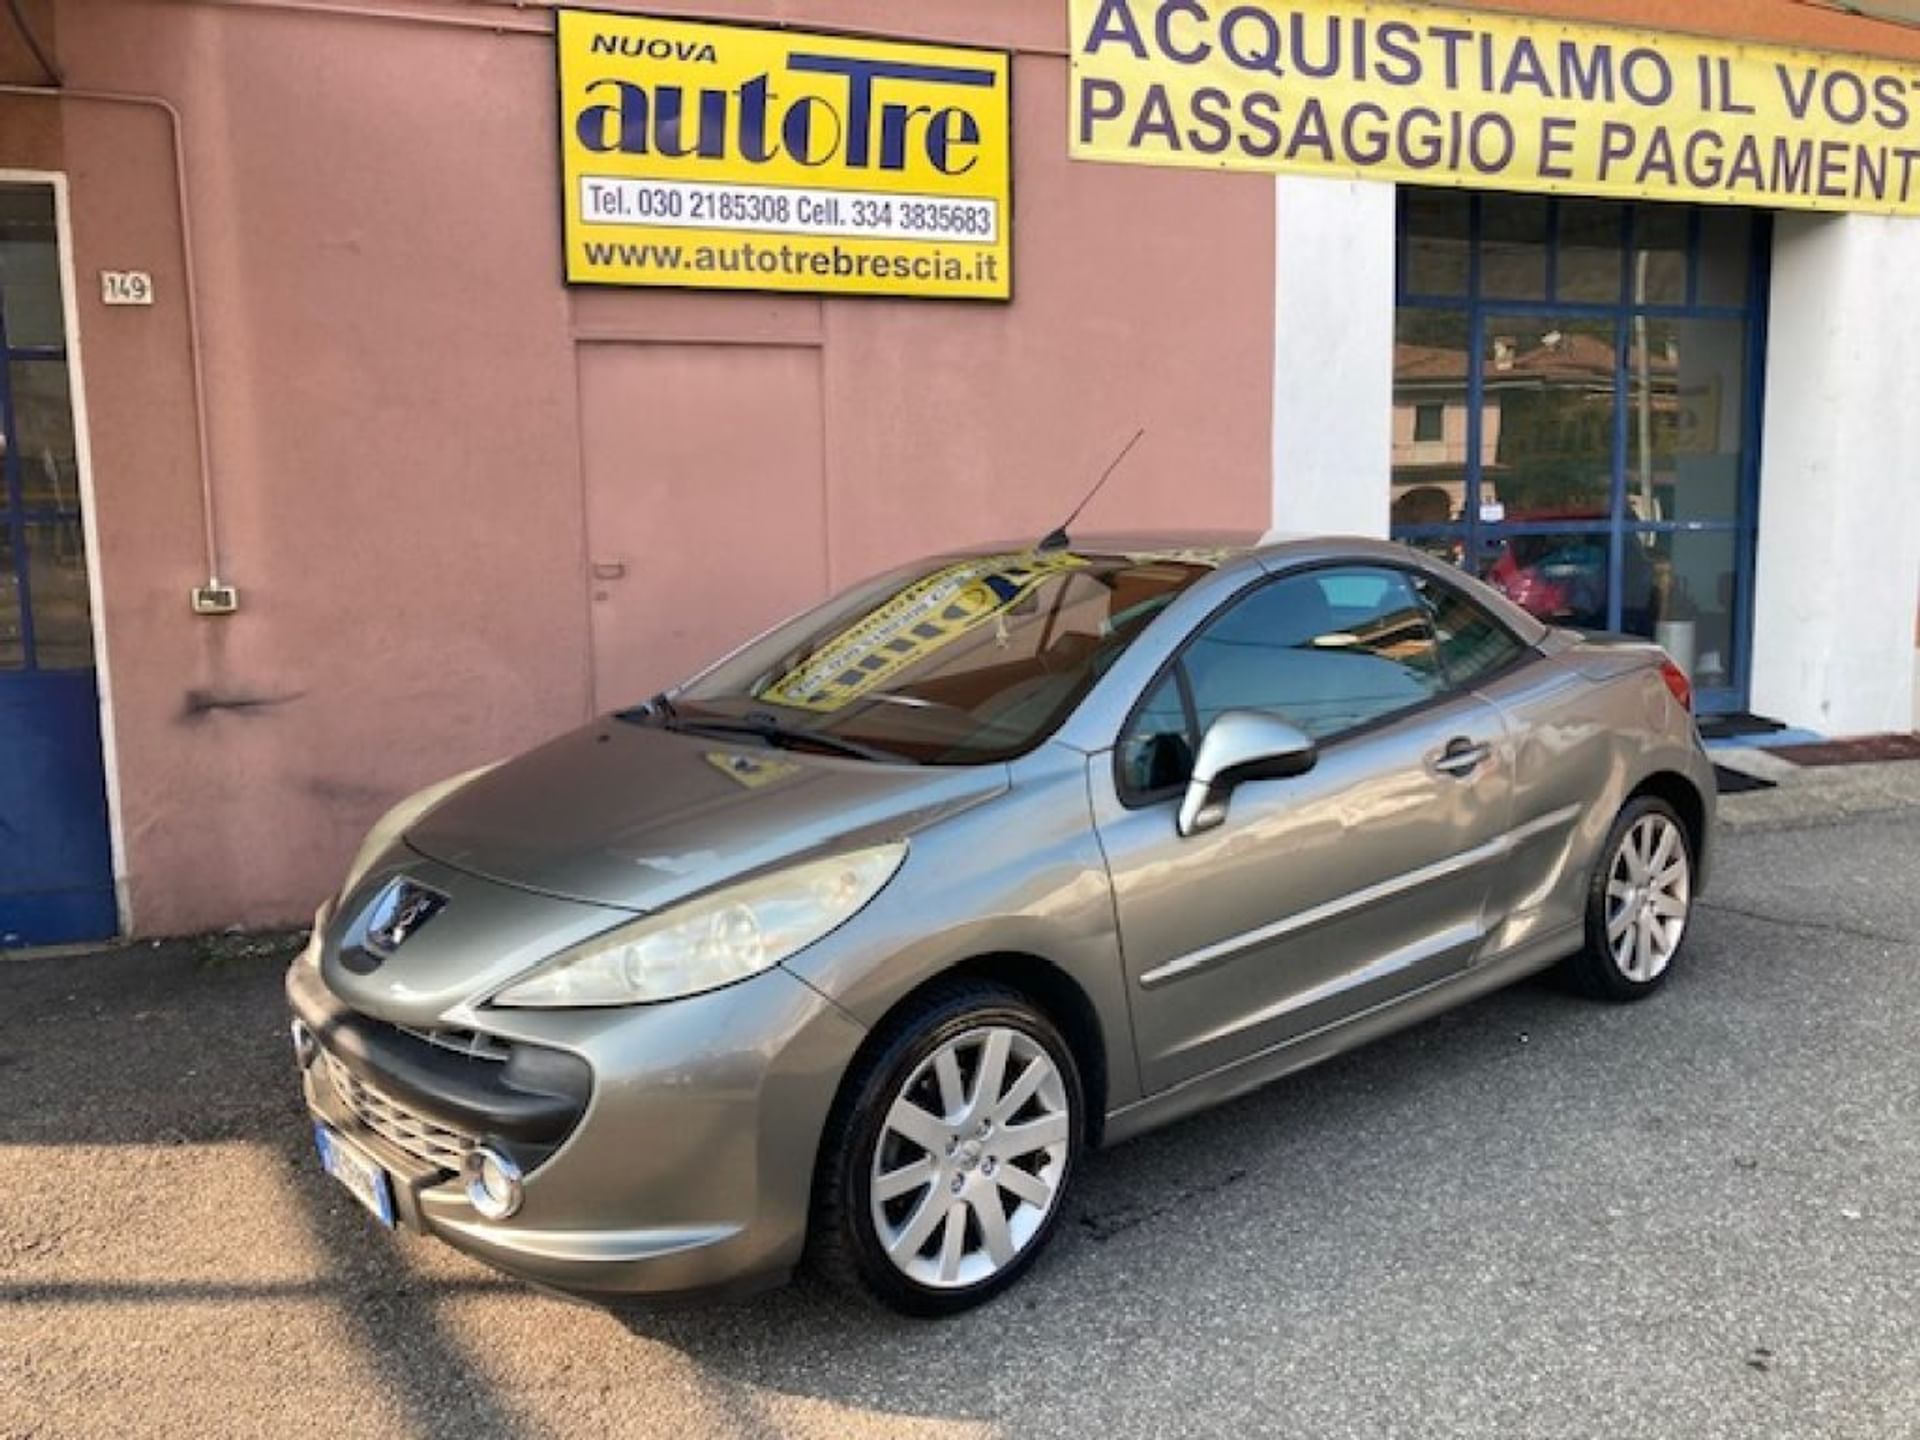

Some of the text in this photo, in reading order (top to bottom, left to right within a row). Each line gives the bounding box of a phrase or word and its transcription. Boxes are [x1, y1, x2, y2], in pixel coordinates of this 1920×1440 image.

[591, 33, 717, 63] NUOVA
[1083, 0, 1920, 130] ACQUISTIAMO IL VOS
[576, 51, 996, 175] autoTre
[1079, 77, 1920, 201] PASSAGGIO E PAGAMENT
[589, 186, 991, 235] Tel. 030 2185308 Cell. 334 3835683
[583, 241, 998, 282] www.autotrebrescia.it
[108, 275, 145, 299] 149
